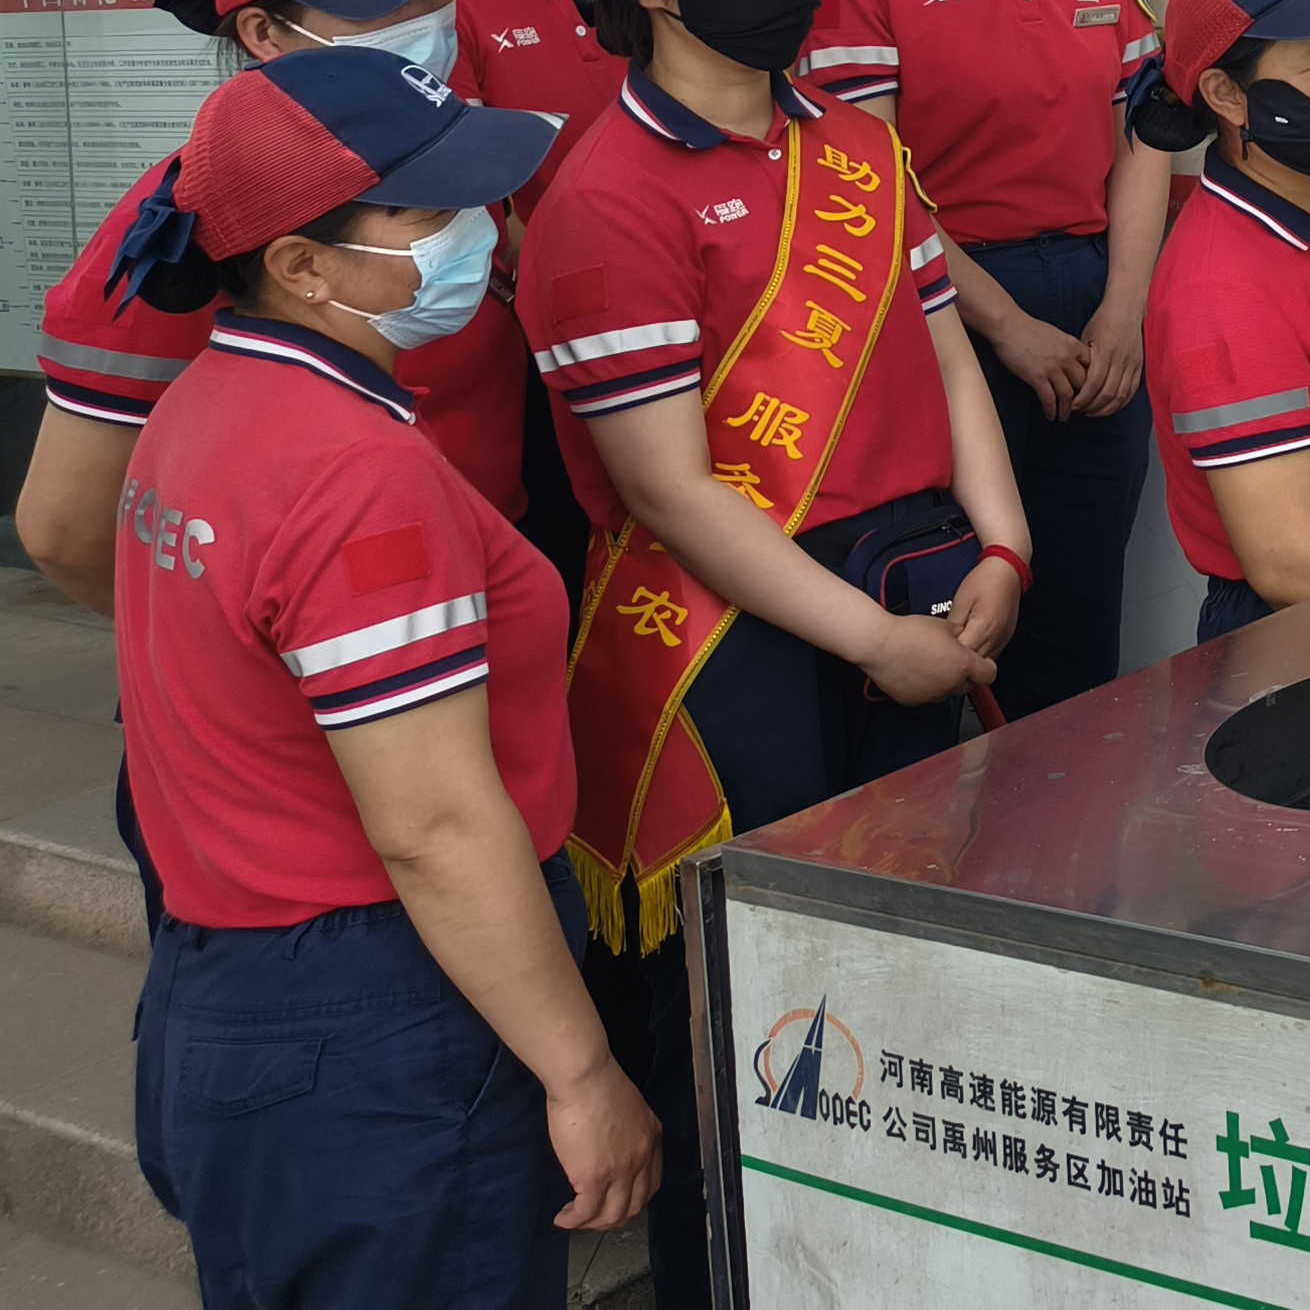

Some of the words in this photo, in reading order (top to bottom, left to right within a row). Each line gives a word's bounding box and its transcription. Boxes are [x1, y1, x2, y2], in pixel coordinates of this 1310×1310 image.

[879, 1048, 1189, 1161] 河南高速能源有限责任
[882, 1105, 1193, 1219] 公司禹州服务区加油站
